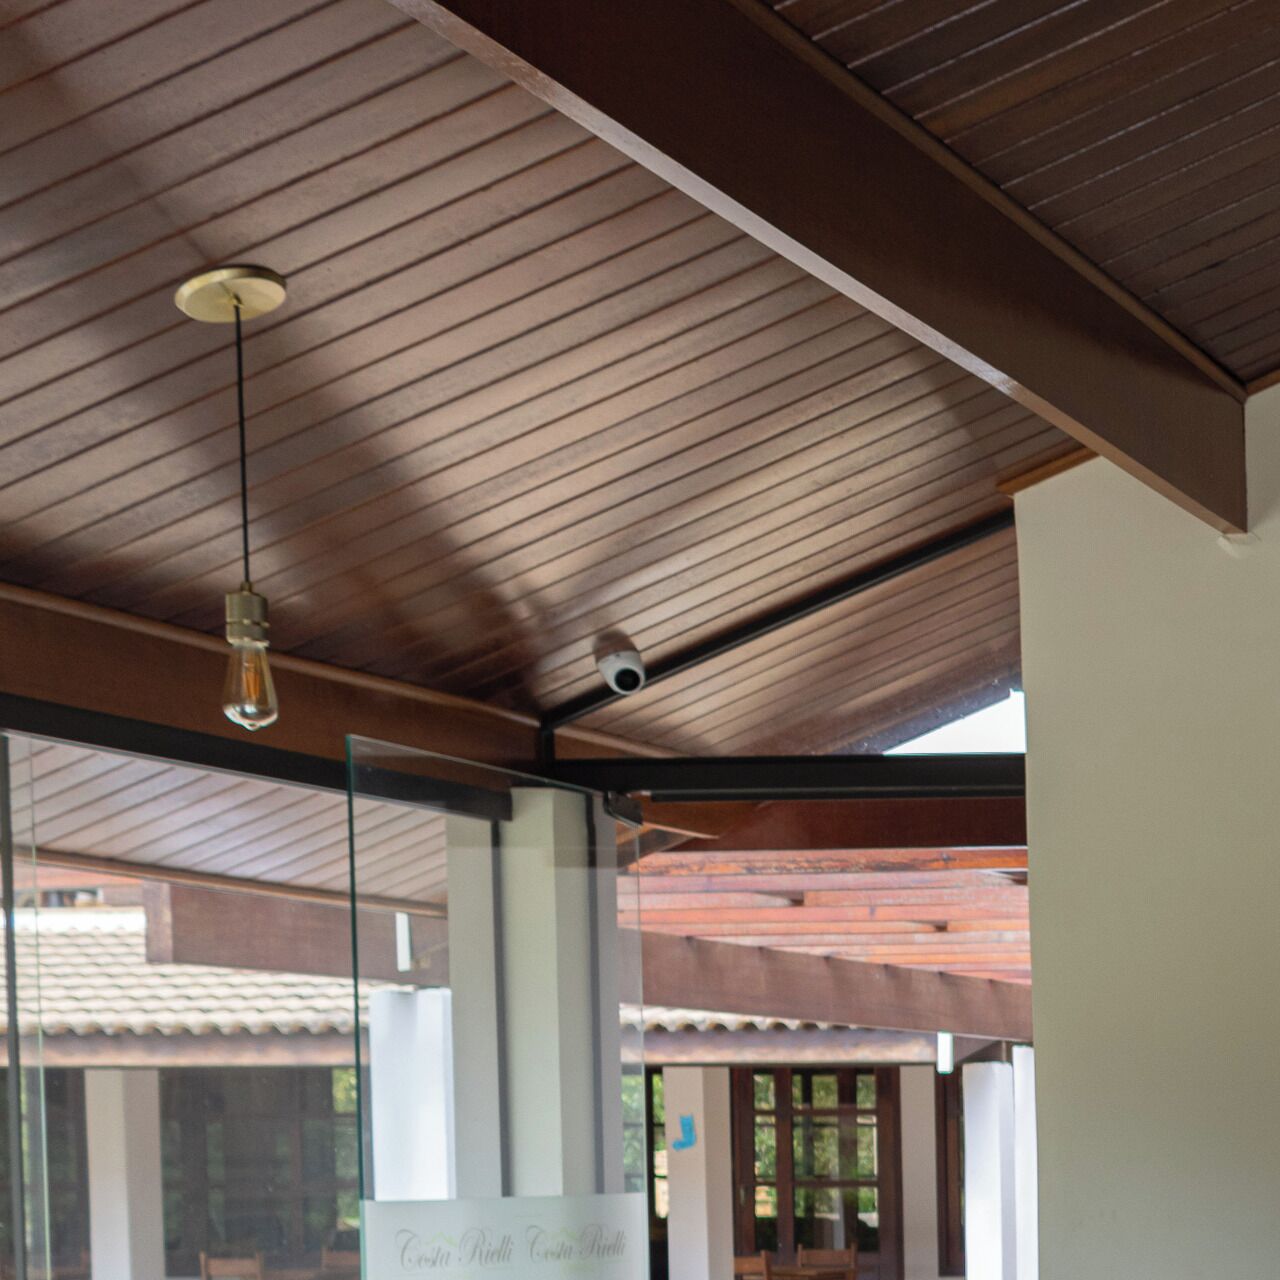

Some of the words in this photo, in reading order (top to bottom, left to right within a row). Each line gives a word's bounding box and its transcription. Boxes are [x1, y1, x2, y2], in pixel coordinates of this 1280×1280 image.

[394, 1228, 450, 1272] Costa
[456, 1226, 514, 1267] Rielli
[524, 1224, 574, 1264] Costa
[577, 1223, 626, 1260] Rielli
